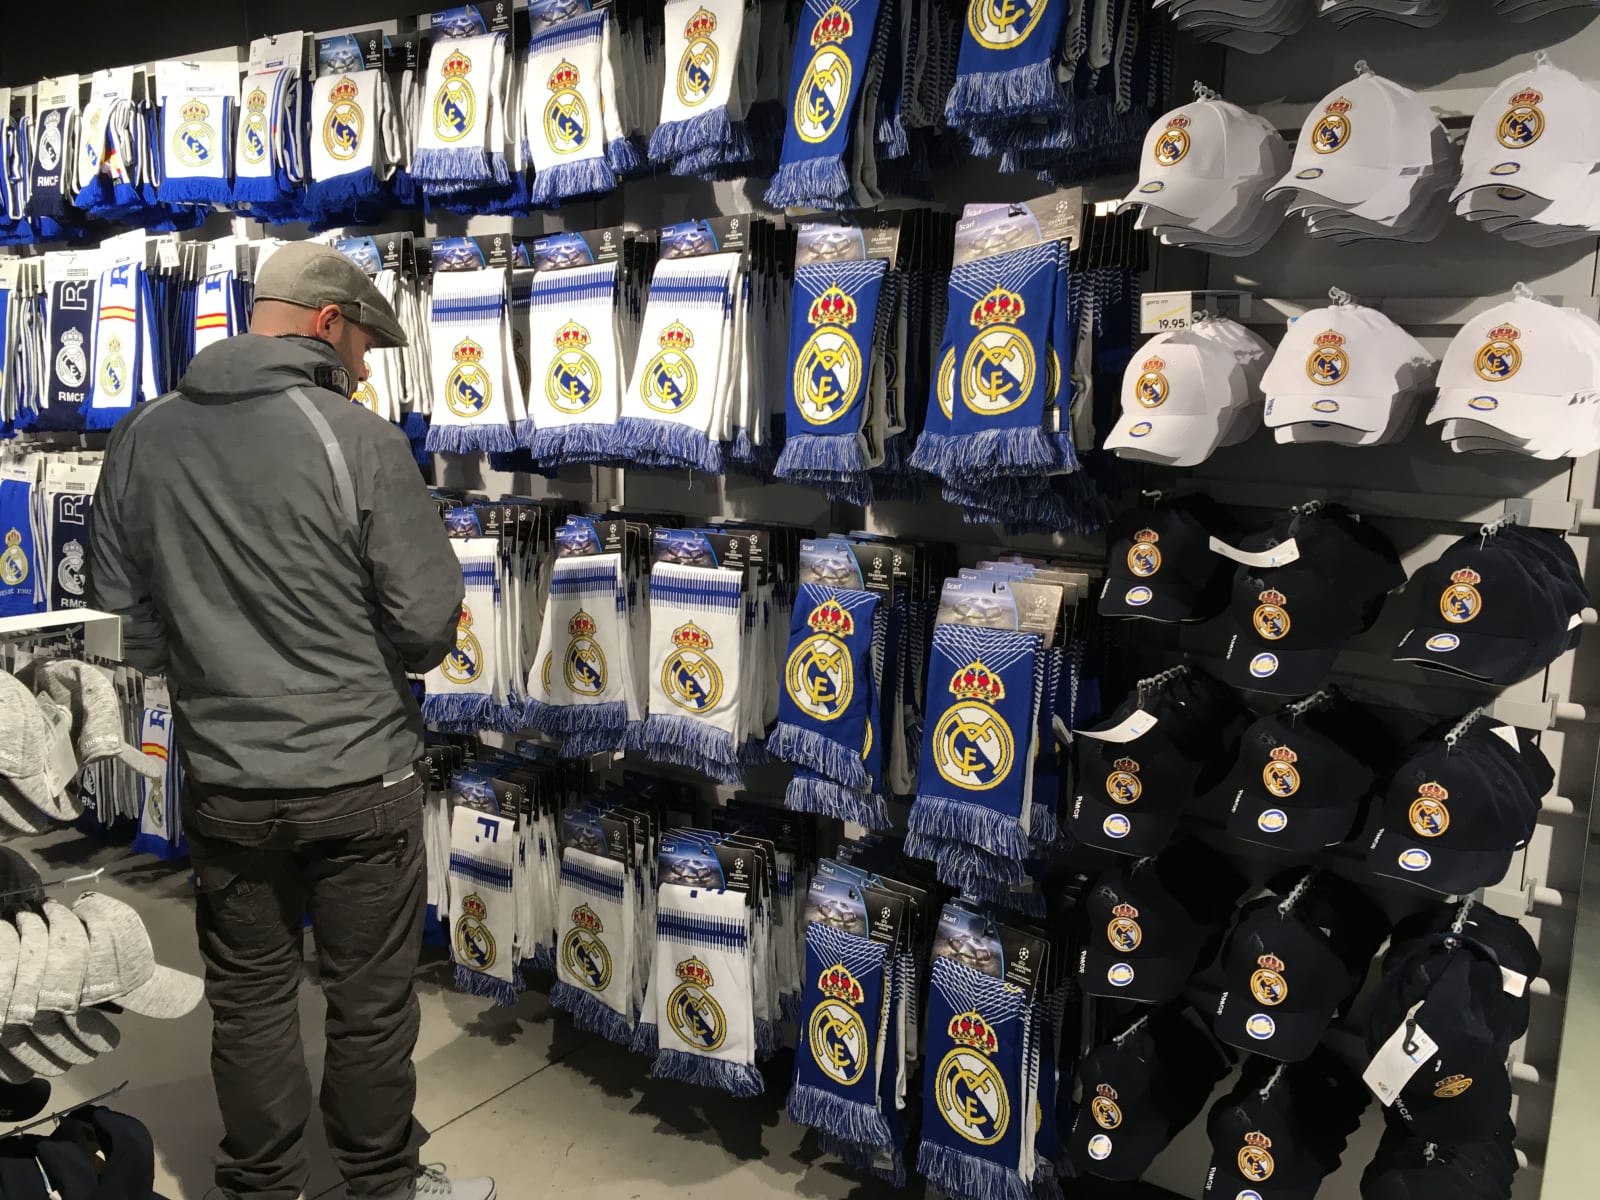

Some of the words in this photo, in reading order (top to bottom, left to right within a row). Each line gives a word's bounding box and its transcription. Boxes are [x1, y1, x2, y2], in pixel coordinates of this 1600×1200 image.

[37, 175, 59, 187] RMCF
[959, 219, 975, 231] Scarf
[60, 280, 88, 310] R
[58, 391, 85, 402] RMCF
[59, 495, 87, 526] R
[655, 532, 668, 540] Scarf
[802, 544, 814, 552] Scarf
[946, 582, 962, 590] Scarf
[61, 598, 87, 608] RMCF
[661, 845, 675, 853] Scarf
[820, 864, 834, 874] Scarf
[812, 882, 825, 891] Scarf
[942, 913, 956, 923] Scarf
